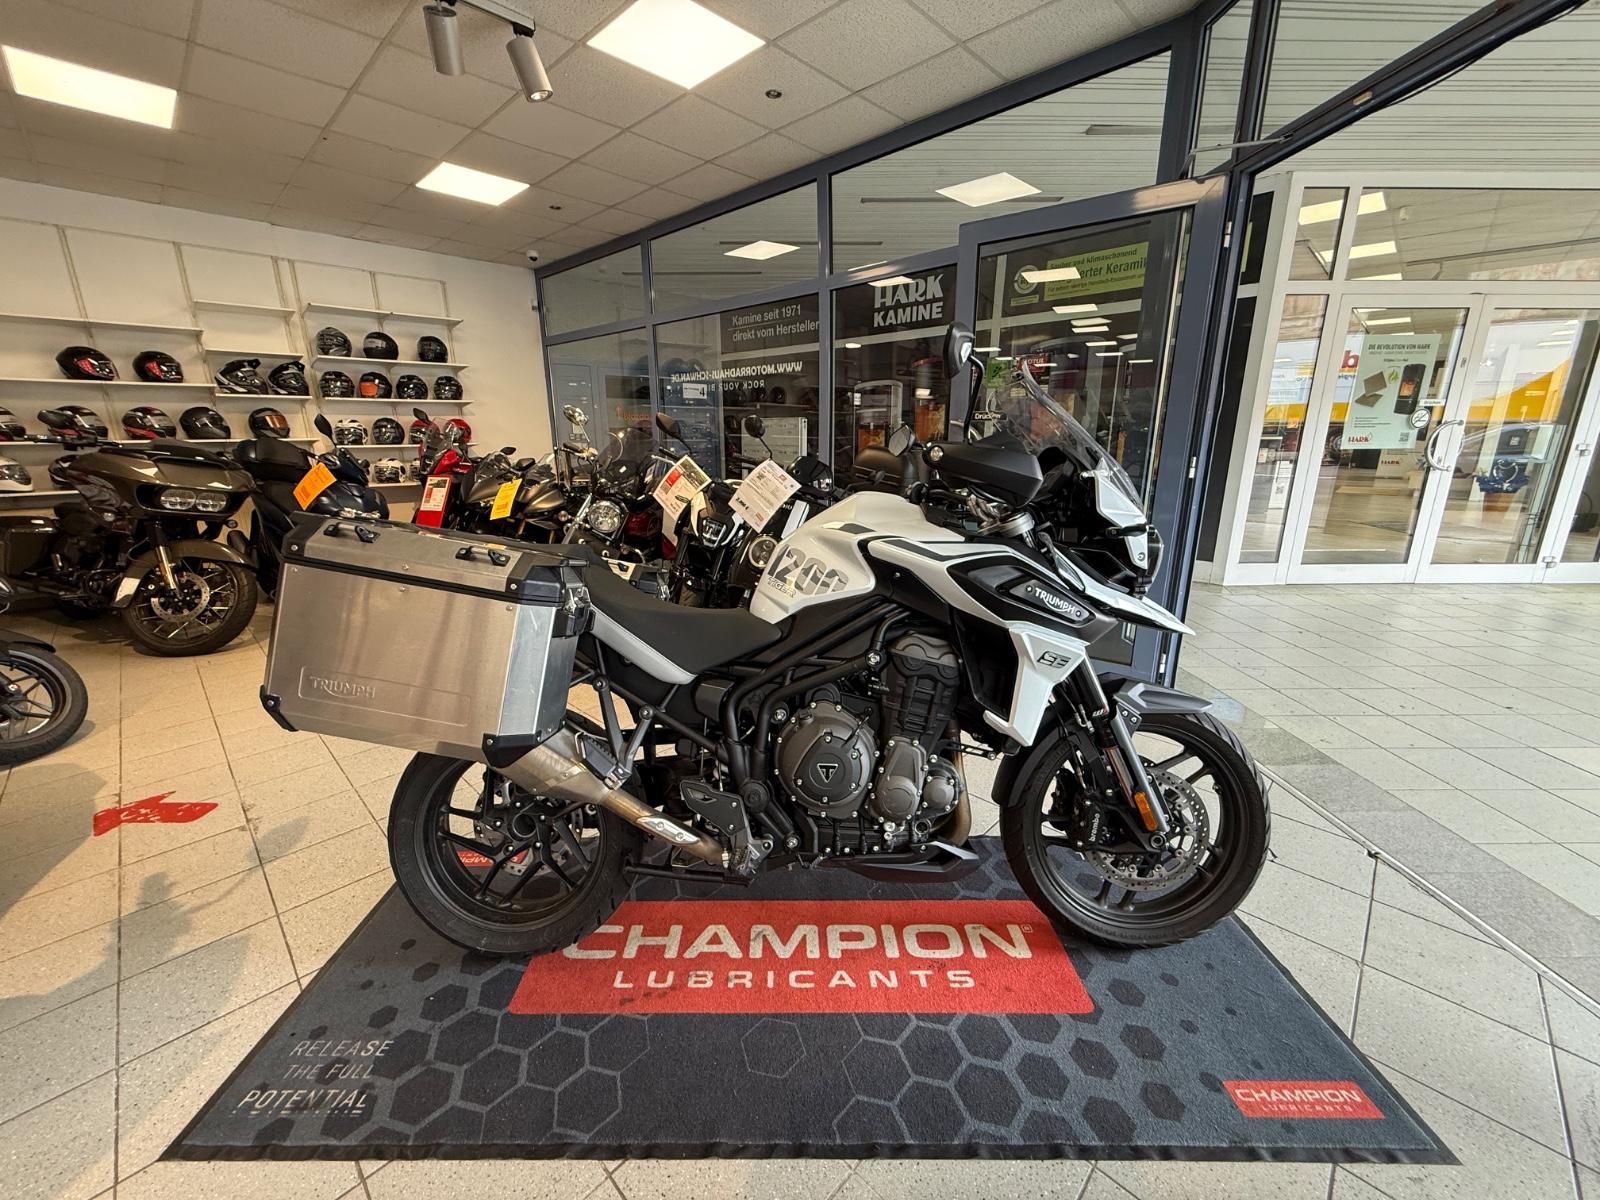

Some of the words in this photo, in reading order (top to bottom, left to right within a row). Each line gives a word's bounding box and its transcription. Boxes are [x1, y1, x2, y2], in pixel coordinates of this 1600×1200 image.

[873, 273, 944, 308] HARK
[732, 311, 762, 327] Kamine
[763, 308, 780, 323] seit
[781, 304, 802, 319] 1971
[873, 302, 943, 327] KAMINE
[732, 327, 755, 342] direkt
[756, 328, 775, 339] vom
[775, 320, 820, 336] Hersteller
[1034, 587, 1076, 615] TRIUMPH
[310, 676, 376, 699] TRIUMPH
[1088, 812, 1101, 842] brembo
[563, 924, 1033, 959] CHAMPION
[613, 970, 976, 989] LUBRICANTS
[289, 1040, 395, 1057] RELEASE
[282, 1064, 323, 1080] THE
[325, 1064, 375, 1079] FULL
[232, 1089, 367, 1114] POTENTIAL
[1235, 1088, 1362, 1103] CHAMPION
